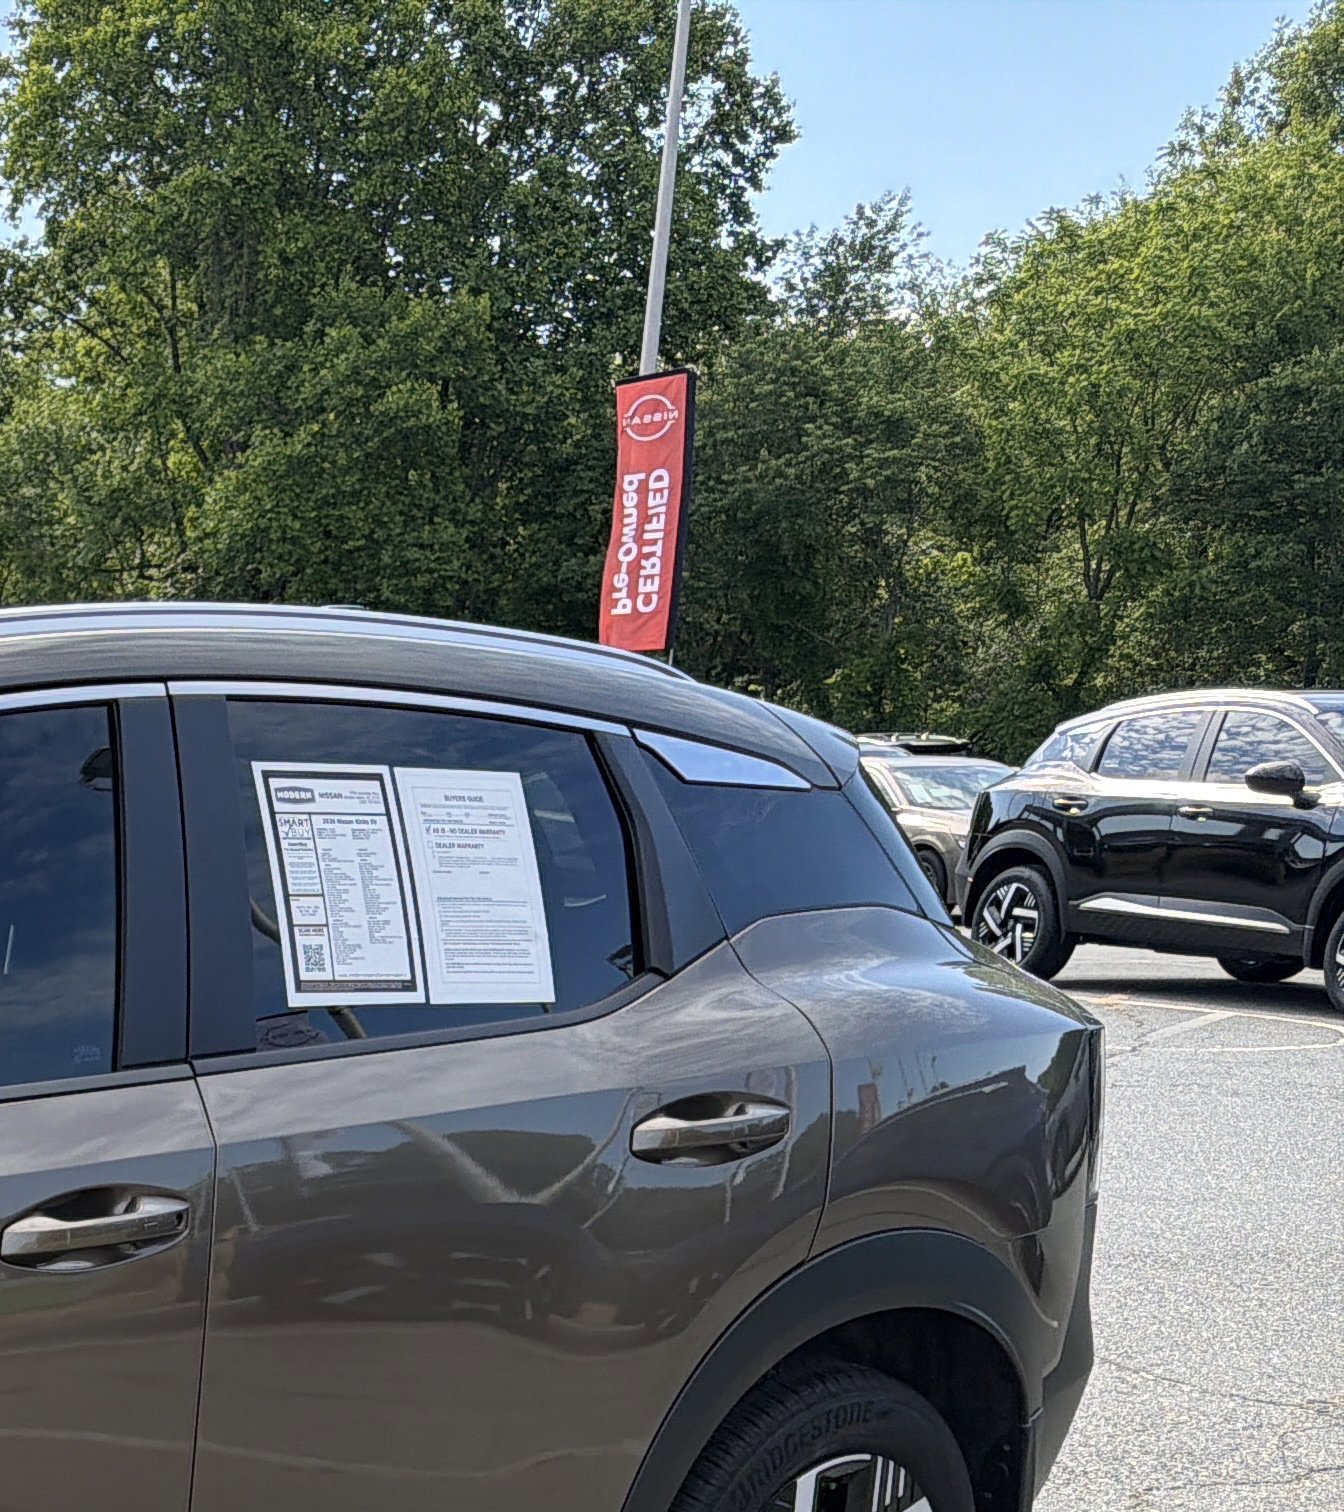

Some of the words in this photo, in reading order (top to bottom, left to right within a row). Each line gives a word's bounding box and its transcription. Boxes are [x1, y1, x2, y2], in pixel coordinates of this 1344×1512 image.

[276, 790, 313, 799] MODERN
[318, 792, 343, 800] NISSAN
[278, 817, 309, 828] SMART
[291, 828, 310, 837] BUY
